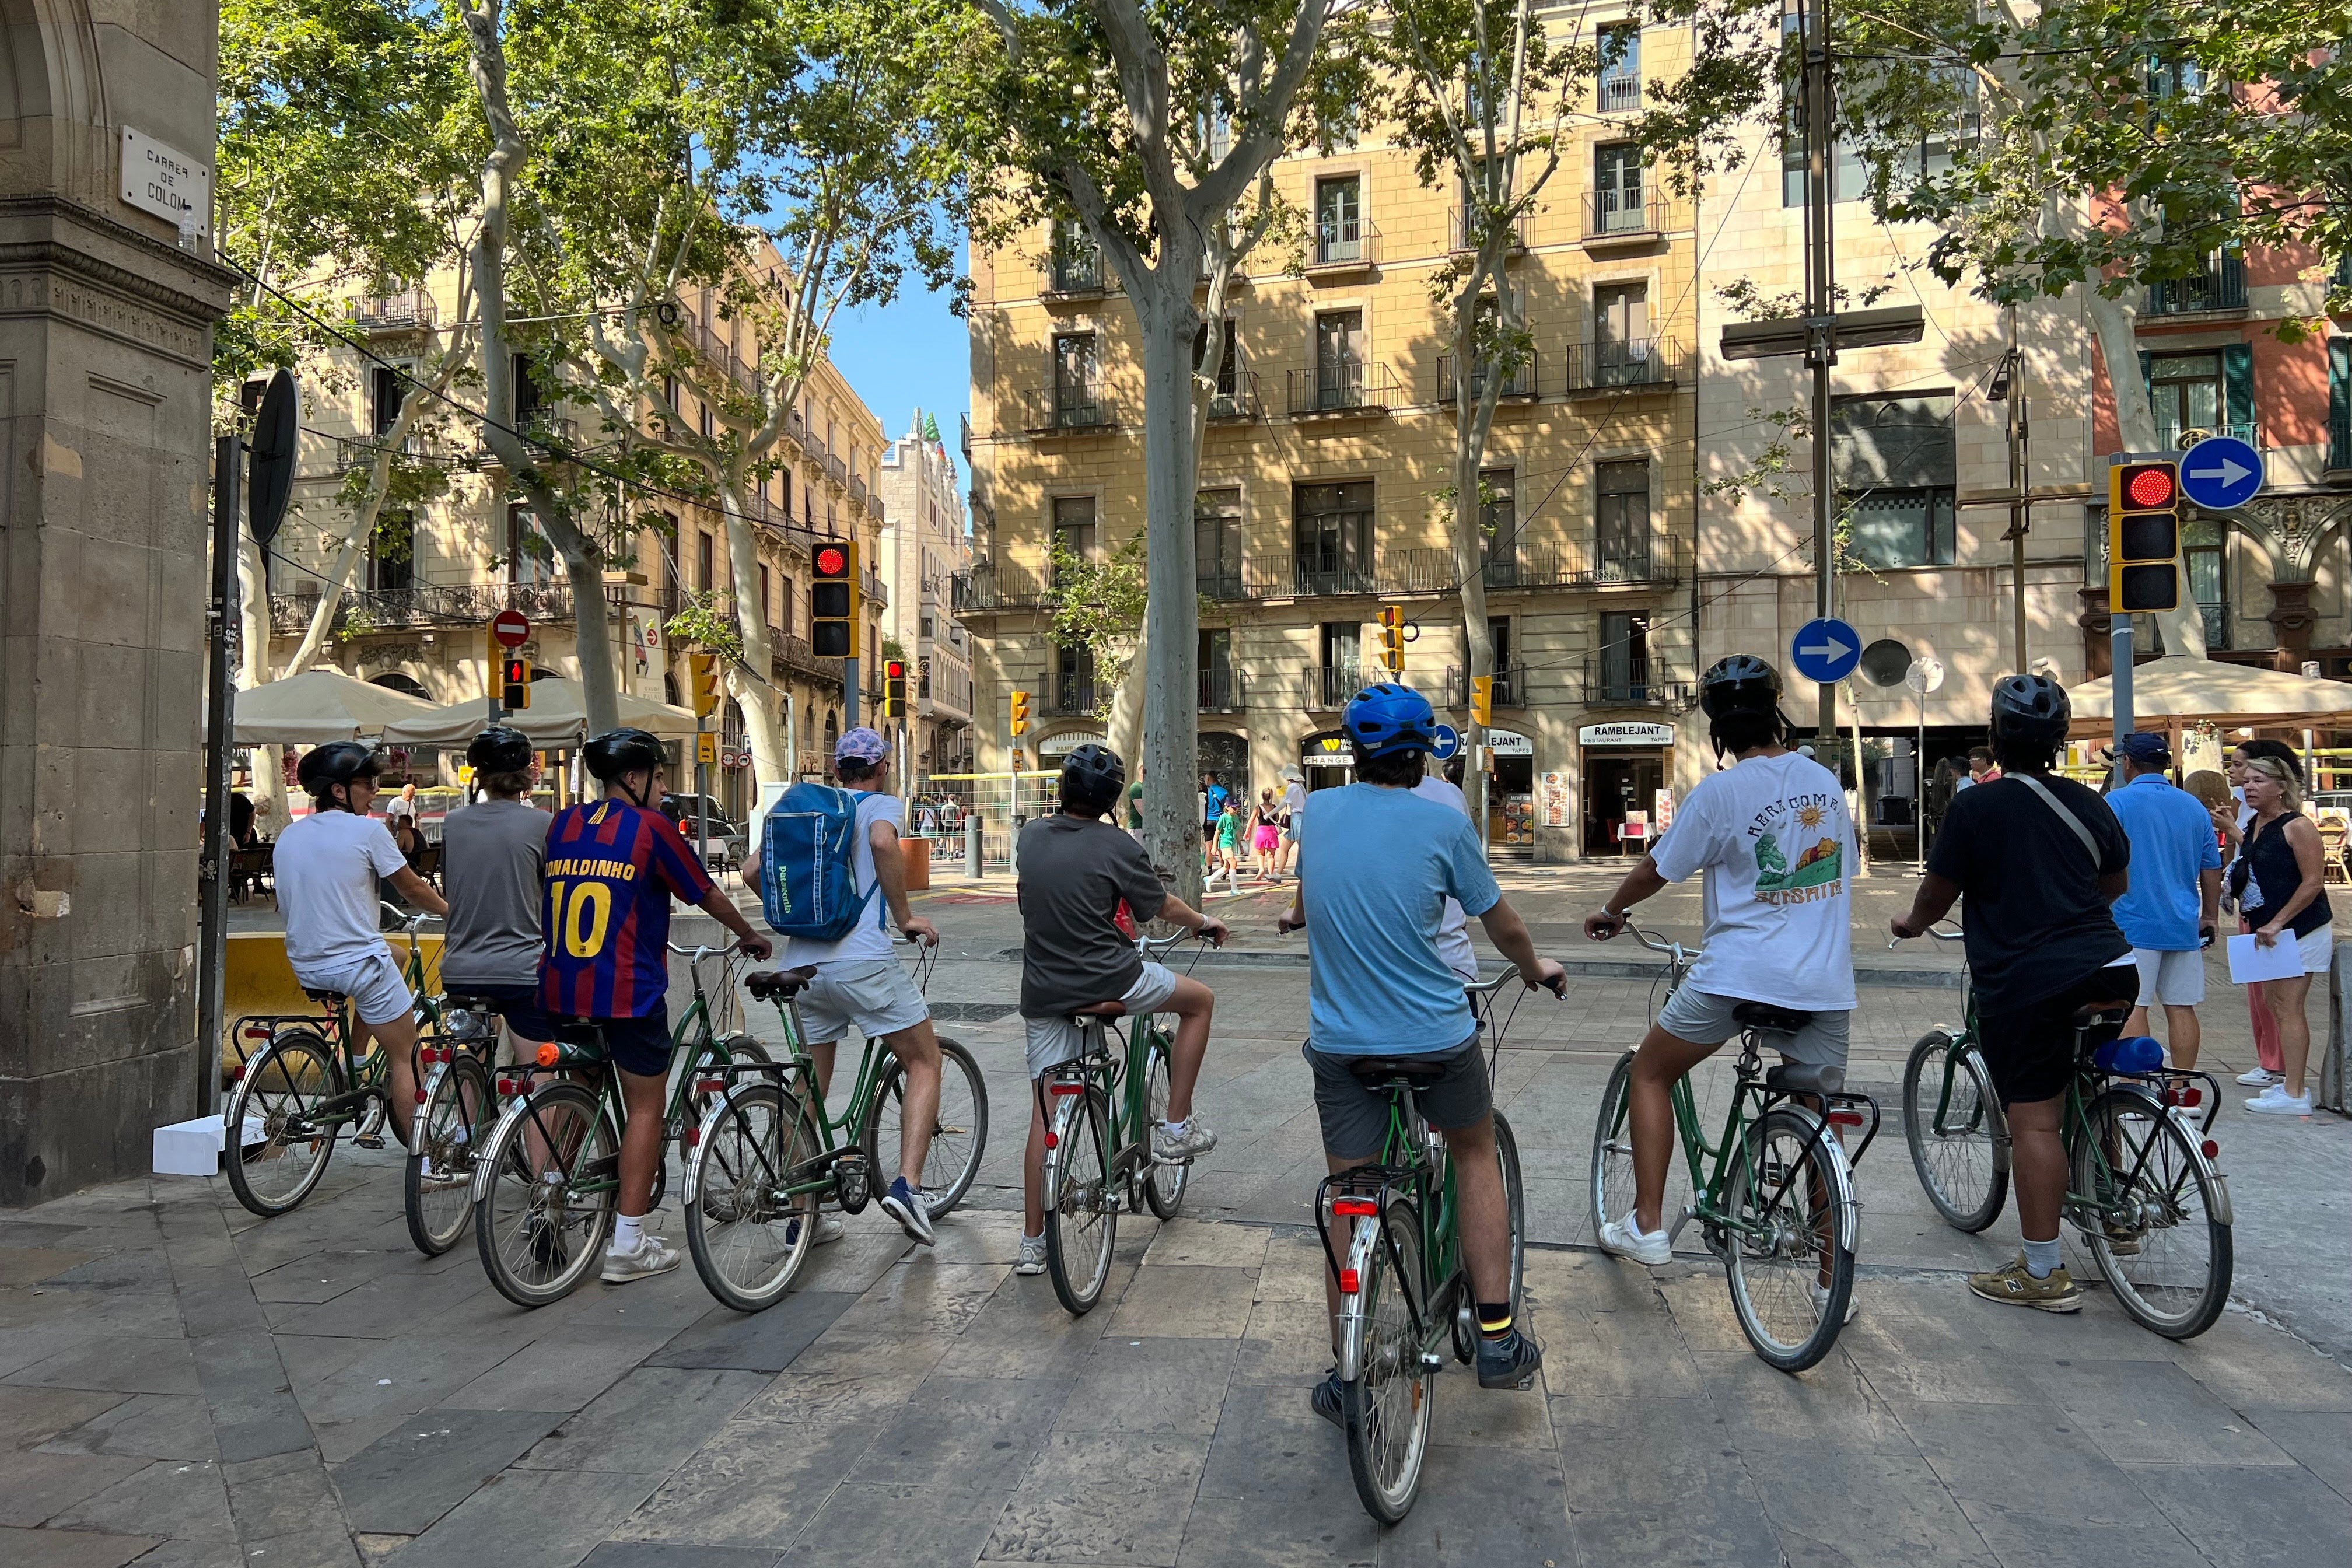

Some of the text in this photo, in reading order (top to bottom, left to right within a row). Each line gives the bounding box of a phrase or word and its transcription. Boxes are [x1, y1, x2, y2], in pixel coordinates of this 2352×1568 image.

[147, 150, 188, 178] CARRER
[160, 172, 174, 187] DE
[148, 182, 186, 211] COLOM
[1595, 726, 1660, 735] RAMBLEJANT
[1747, 800, 1786, 838] HERE
[545, 859, 635, 881] ONALDINHO
[779, 866, 792, 914] patagonia
[551, 881, 611, 958] 10
[643, 1254, 659, 1269] N
[2004, 1278, 2024, 1293] N
